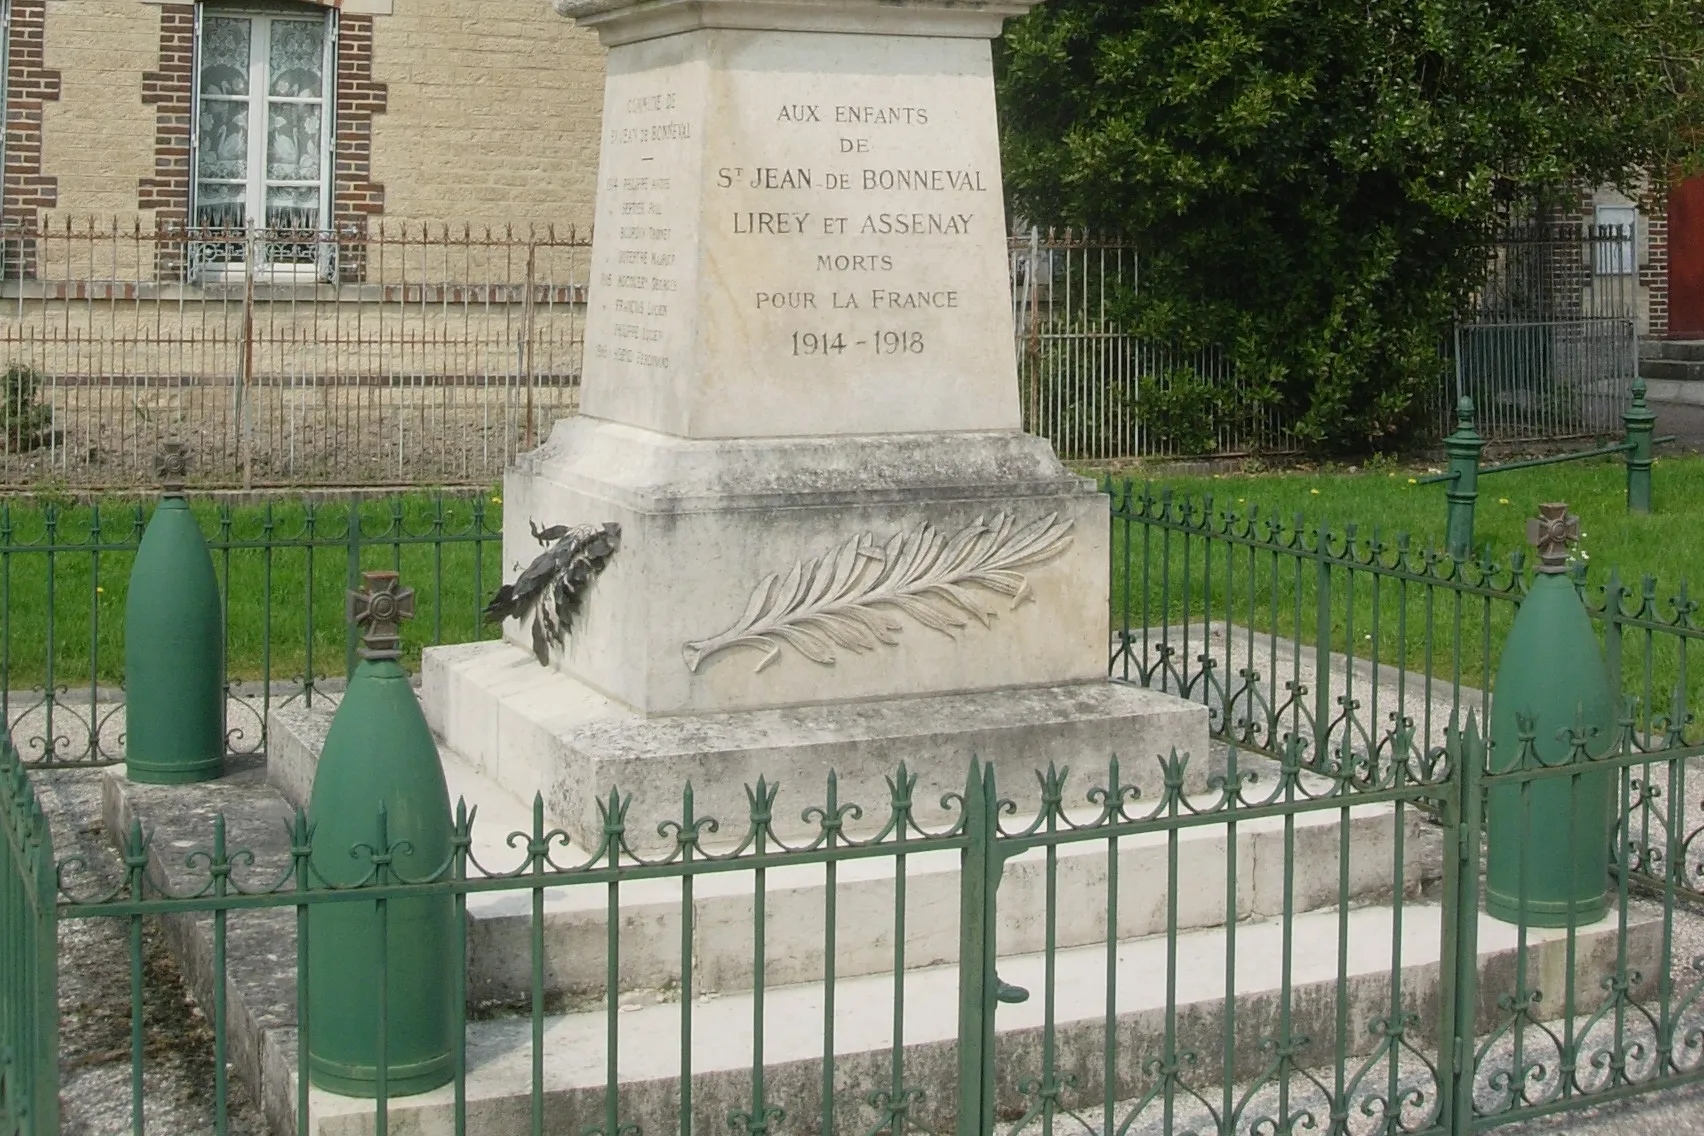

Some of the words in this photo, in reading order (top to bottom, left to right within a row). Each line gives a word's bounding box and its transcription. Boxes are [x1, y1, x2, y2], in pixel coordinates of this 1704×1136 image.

[777, 105, 820, 122] AUX
[835, 106, 928, 124] ENFANTS
[840, 138, 870, 153] DE
[750, 167, 812, 190] JEAN
[825, 173, 851, 190] DE
[863, 169, 987, 192] BONNEVAL
[733, 212, 811, 235] LIREY
[823, 217, 848, 234] ET
[861, 213, 974, 235] ASSENAY
[816, 255, 893, 271] MORTS
[756, 292, 817, 309] POUR
[832, 292, 860, 309] LA
[872, 289, 958, 308] FRANCE
[791, 331, 847, 356] 1914
[873, 330, 925, 354] 1918
